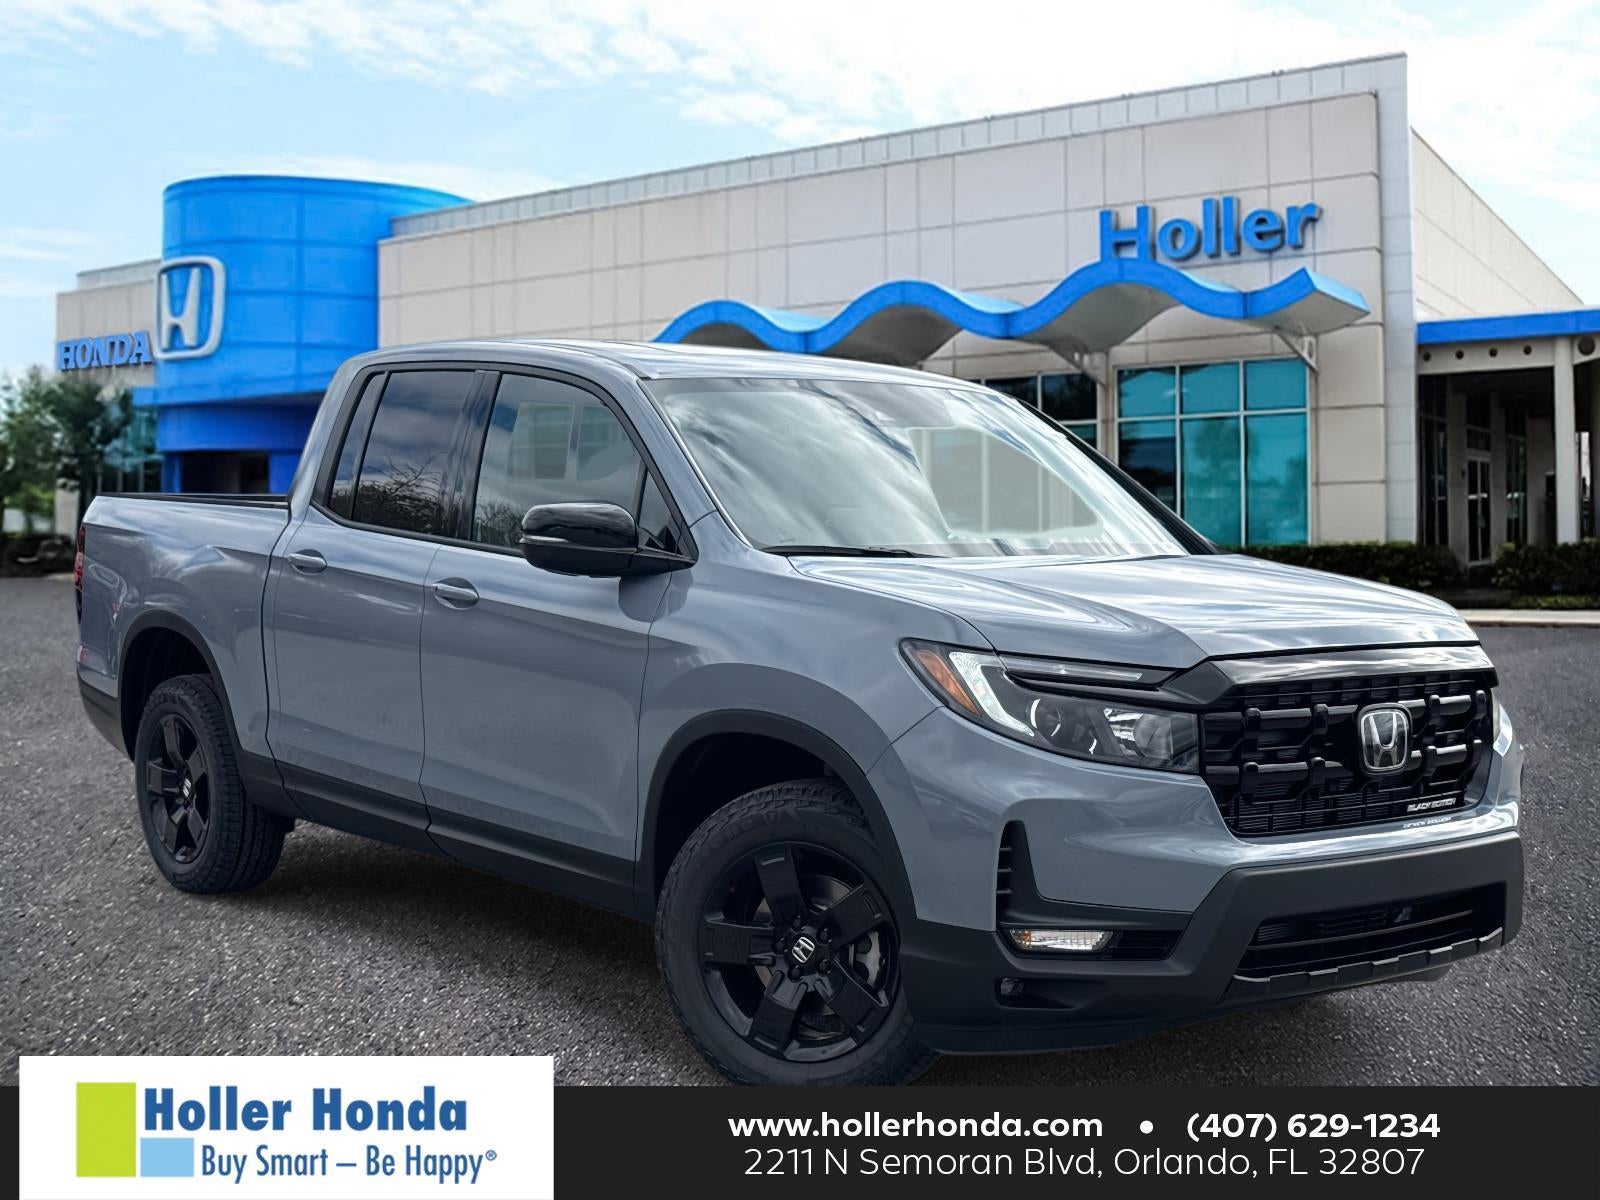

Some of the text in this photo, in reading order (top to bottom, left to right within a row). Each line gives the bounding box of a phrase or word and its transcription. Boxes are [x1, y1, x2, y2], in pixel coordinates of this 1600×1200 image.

[1099, 196, 1322, 262] Holler
[57, 331, 152, 371] HONDA
[1407, 797, 1457, 812] BLACK EDITION
